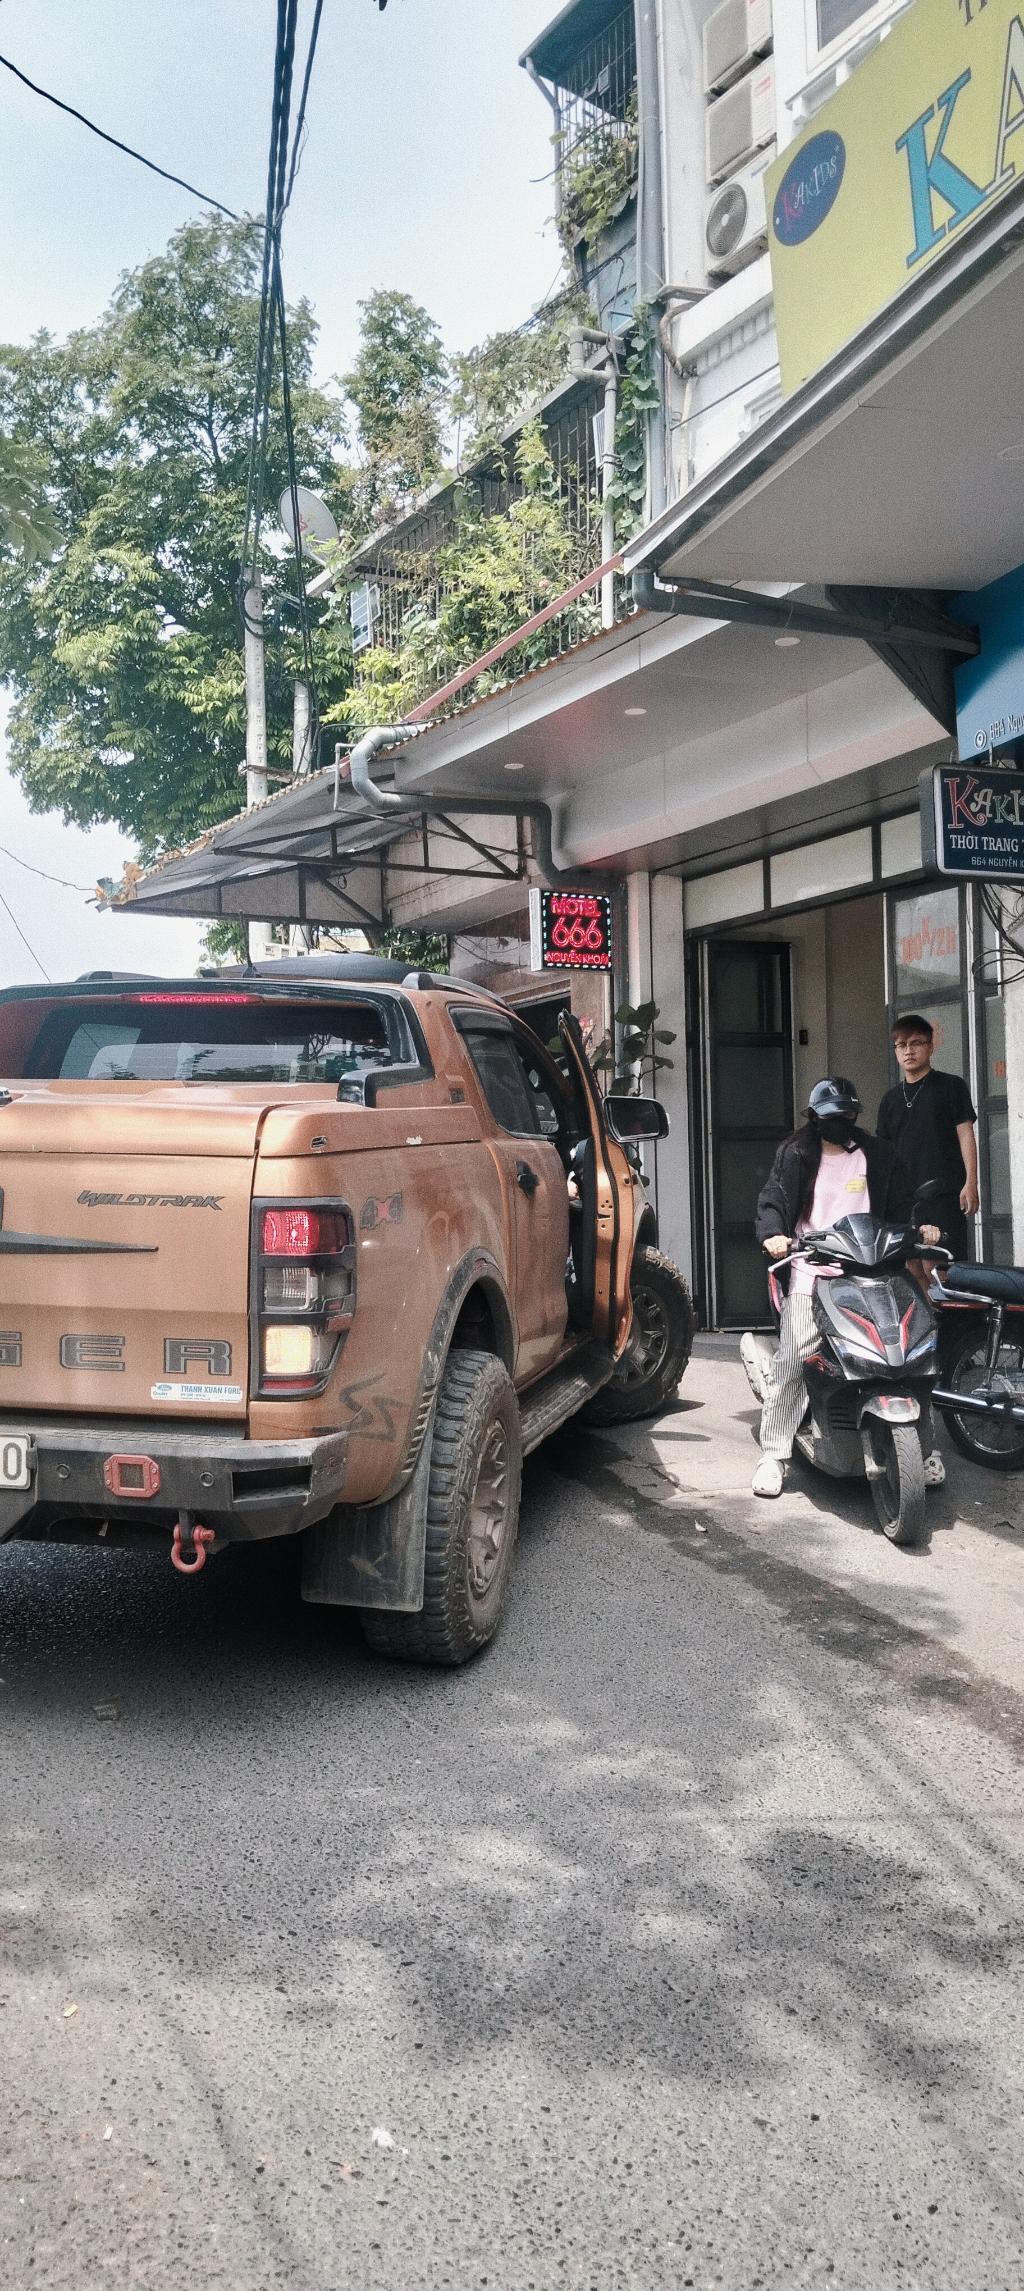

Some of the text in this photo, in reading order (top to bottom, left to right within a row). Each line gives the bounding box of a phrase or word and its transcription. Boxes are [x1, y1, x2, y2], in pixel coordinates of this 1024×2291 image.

[782, 155, 838, 232] KAKIDS
[944, 774, 1024, 828] KAKI
[950, 831, 979, 850] THỜI
[981, 836, 1019, 853] TRANG
[971, 857, 986, 866] 664
[551, 896, 601, 917] MOTEL
[552, 917, 603, 949] 666
[77, 1190, 226, 1210] WILDTRAK
[180, 1385, 203, 1393] THANH
[204, 1386, 223, 1394] XUAN
